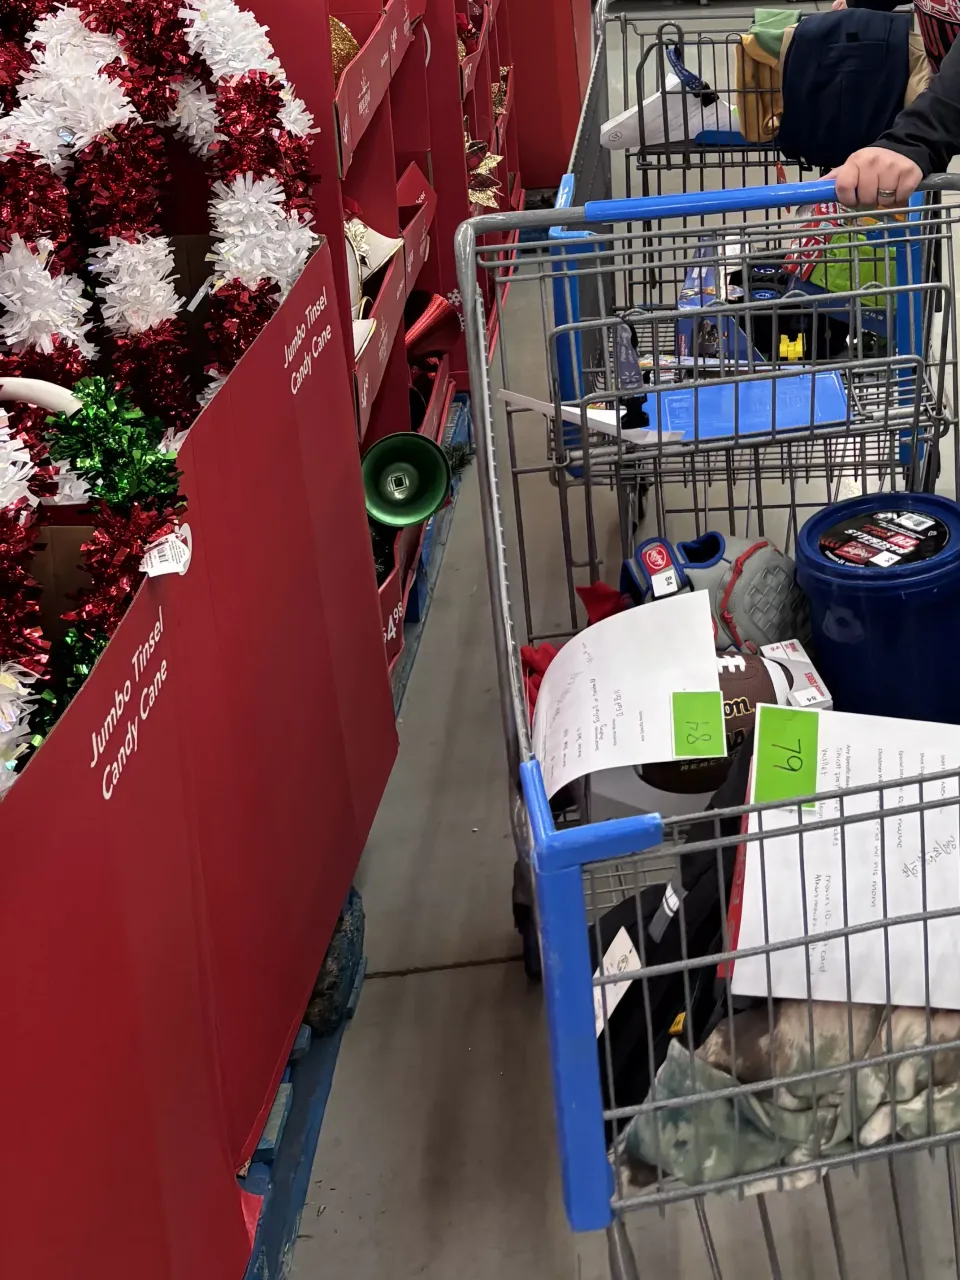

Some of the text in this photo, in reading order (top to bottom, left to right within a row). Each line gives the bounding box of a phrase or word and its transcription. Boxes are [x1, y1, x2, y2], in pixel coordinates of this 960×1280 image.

[282, 286, 328, 369] Jumbo Tinsel
[290, 324, 333, 396] Candy Cane
[90, 679, 132, 768] Jumbo
[131, 605, 165, 681] Tinsel
[102, 658, 168, 800] Candy Cane
[771, 738, 804, 773] 79
